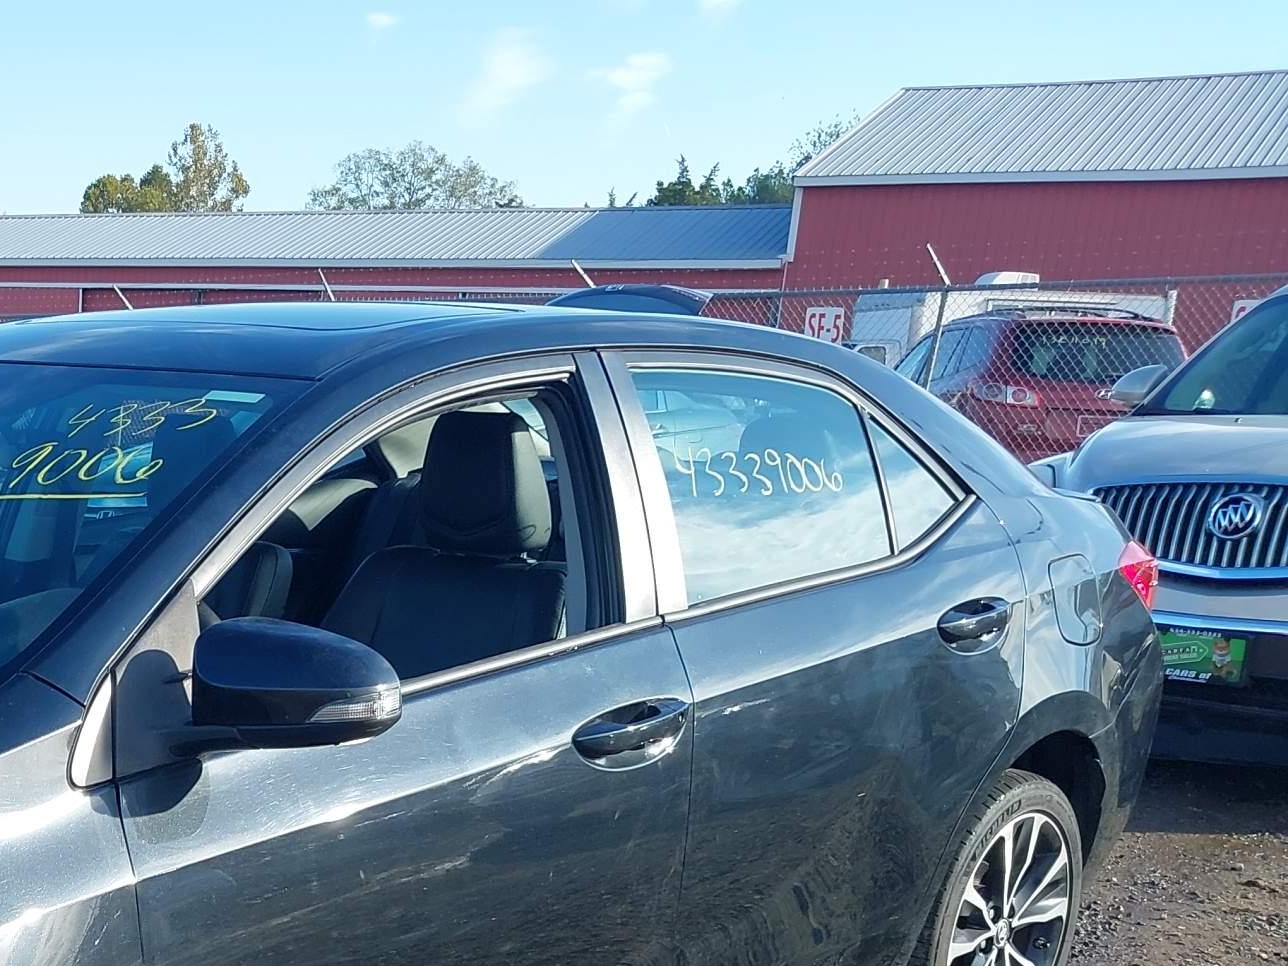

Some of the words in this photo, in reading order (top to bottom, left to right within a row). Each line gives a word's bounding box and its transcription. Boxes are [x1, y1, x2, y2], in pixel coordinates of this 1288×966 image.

[809, 313, 841, 343] SF-5
[9, 441, 163, 489] 9006
[674, 442, 843, 497] 43339006
